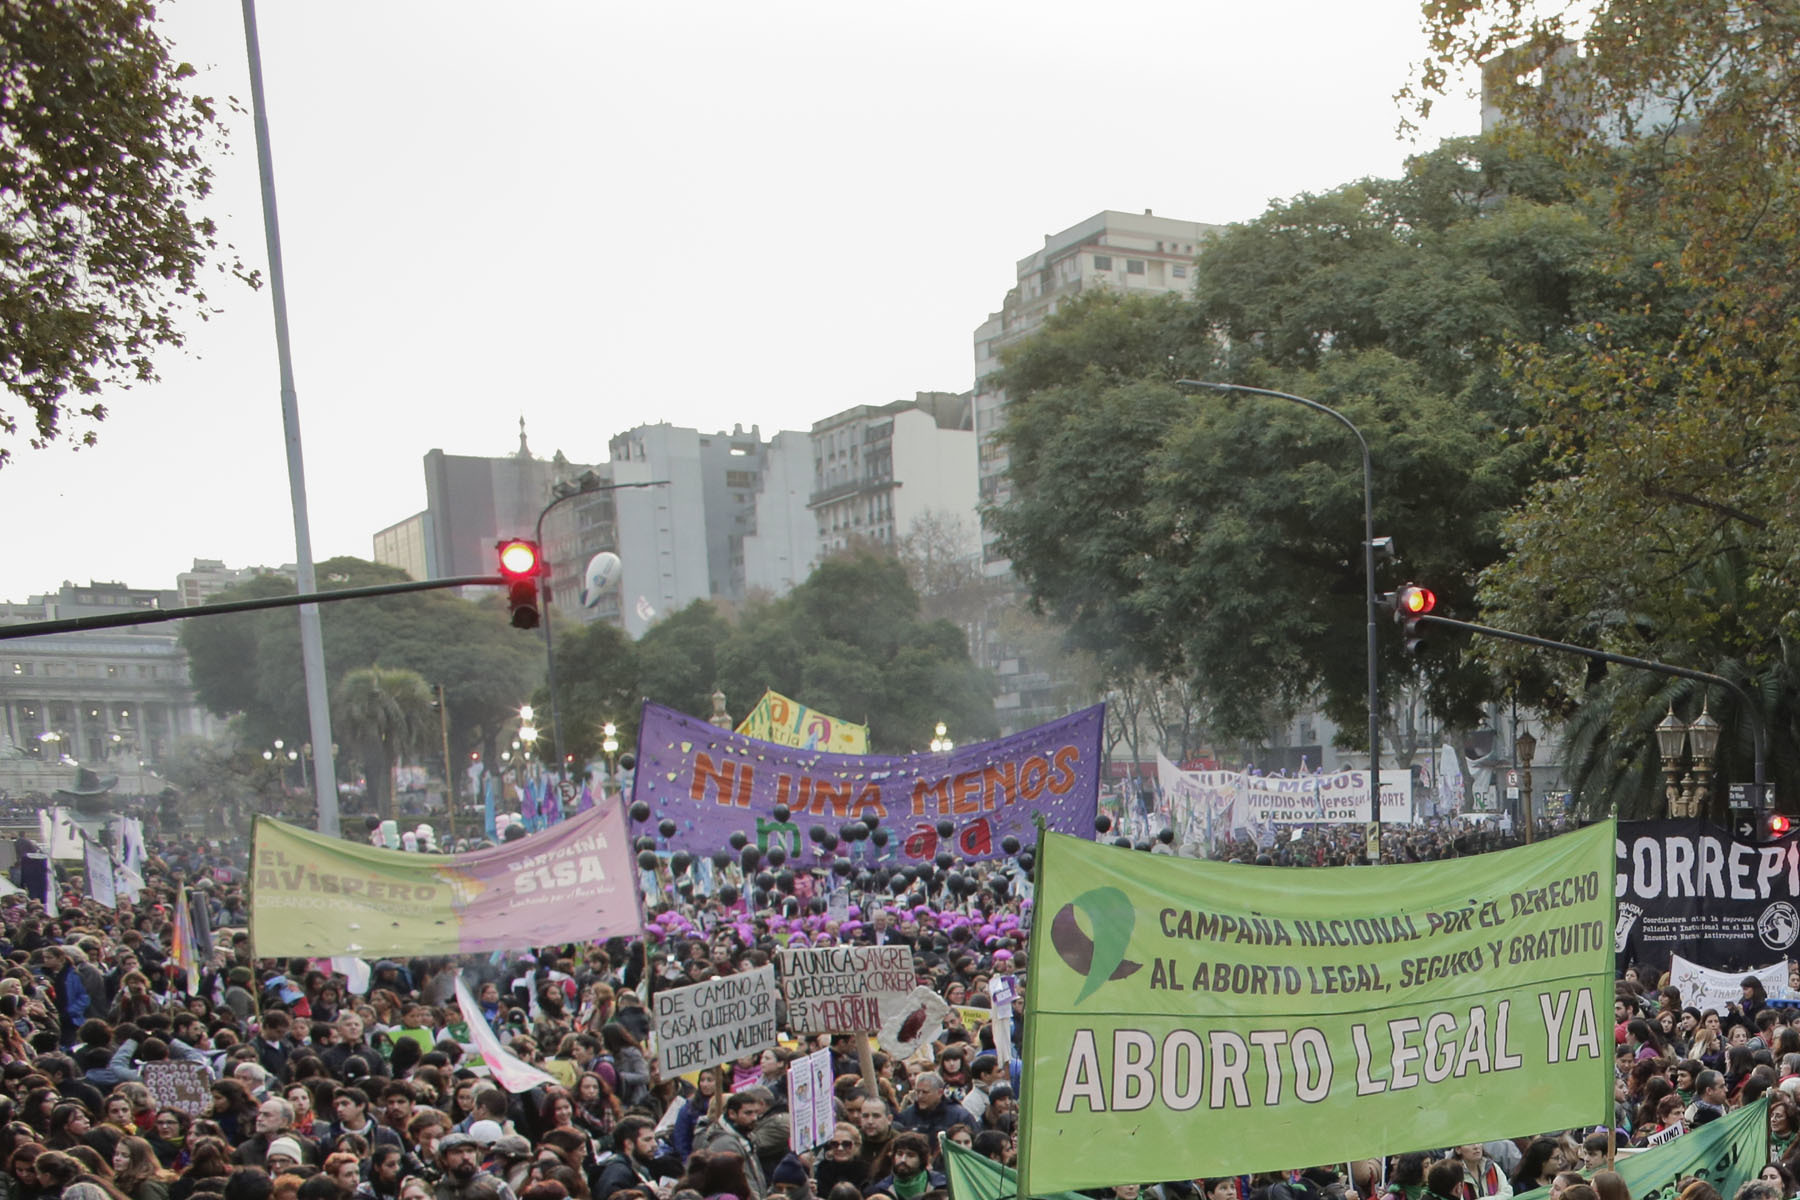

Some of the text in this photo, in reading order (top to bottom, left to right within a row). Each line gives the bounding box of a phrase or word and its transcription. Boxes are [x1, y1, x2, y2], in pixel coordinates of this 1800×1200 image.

[690, 745, 1079, 818] NI UNA MENOS
[259, 851, 290, 868] EL
[514, 855, 605, 895] SISA
[1615, 836, 1800, 899] CORREPI
[257, 864, 437, 901] AVISPERO
[1159, 870, 1599, 948] CAMPAÑA NACIONAL POR EL DERECHO
[1643, 925, 1670, 933] Policial
[855, 948, 911, 972] SANGRE
[1149, 919, 1604, 996] AL ABORTO LEGAL, SEGURO Y GRATUITO
[660, 974, 767, 1016] DE CAMINO A
[785, 977, 813, 1001] QUE
[868, 970, 914, 993] CORRER
[660, 992, 771, 1041] CASA QUIERO SER
[789, 1004, 808, 1018] ES
[791, 1016, 811, 1033] LA
[666, 1019, 775, 1071] LIBRE, NO VALIENTE
[1056, 986, 1602, 1114] ABORTO LEGAL YA
